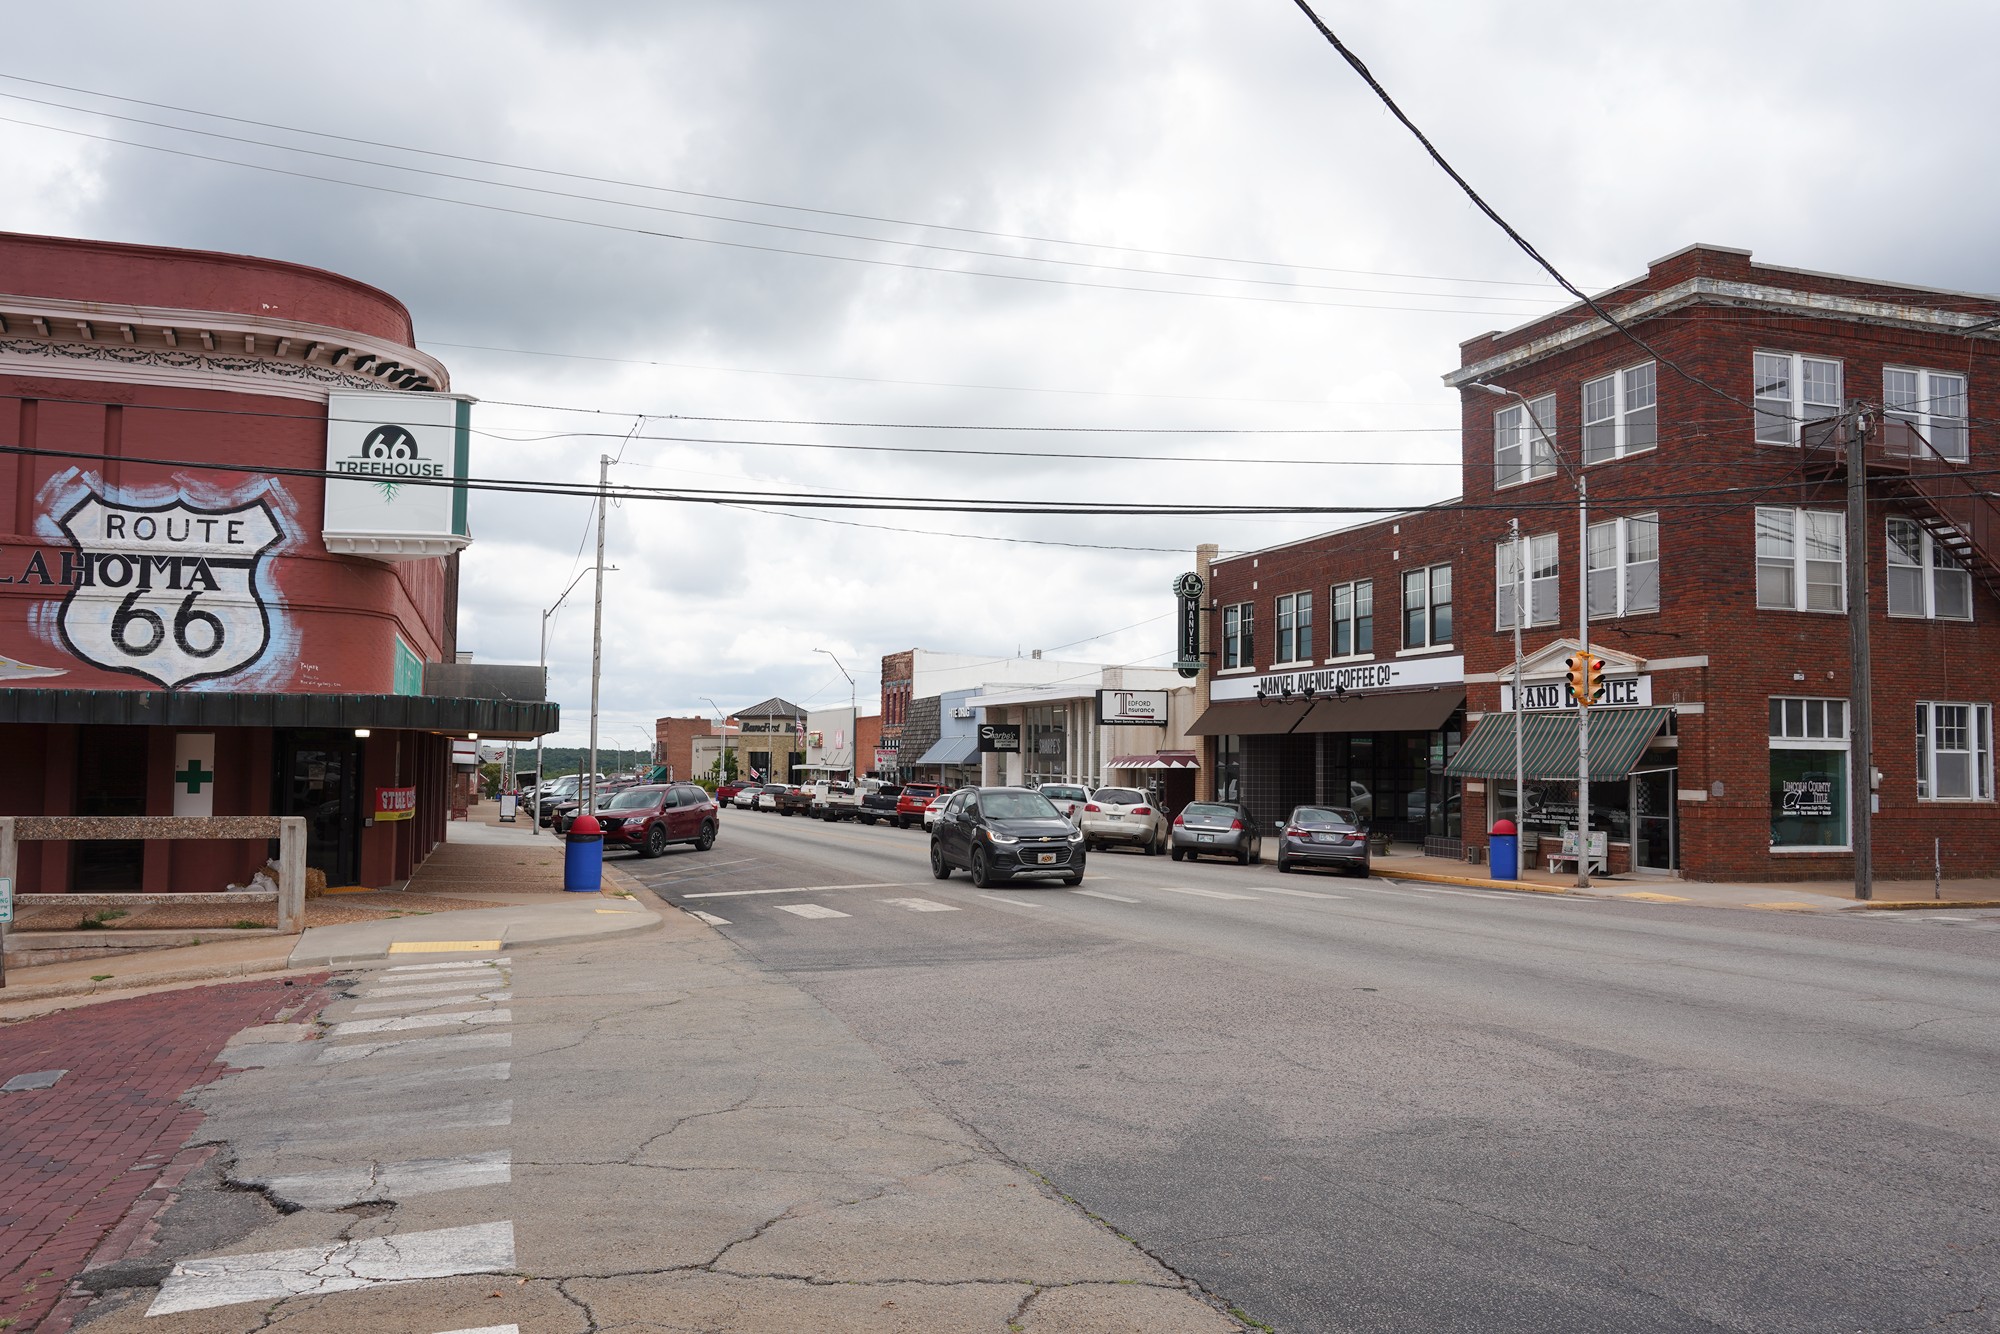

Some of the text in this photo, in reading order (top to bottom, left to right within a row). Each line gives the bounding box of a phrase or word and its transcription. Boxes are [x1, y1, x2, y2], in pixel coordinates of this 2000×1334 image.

[369, 433, 411, 460] 66
[336, 461, 443, 477] TREEHOUSE
[106, 514, 245, 544] ROUTE
[111, 589, 225, 658] 66
[1187, 600, 1195, 654] MANVEL
[1260, 675, 1296, 695] MANVEL
[1297, 670, 1335, 693] AVENUE
[1336, 667, 1375, 690] COFFEE
[1564, 681, 1638, 708] OICE
[1783, 780, 1831, 792] LINCOLN COUNTY
